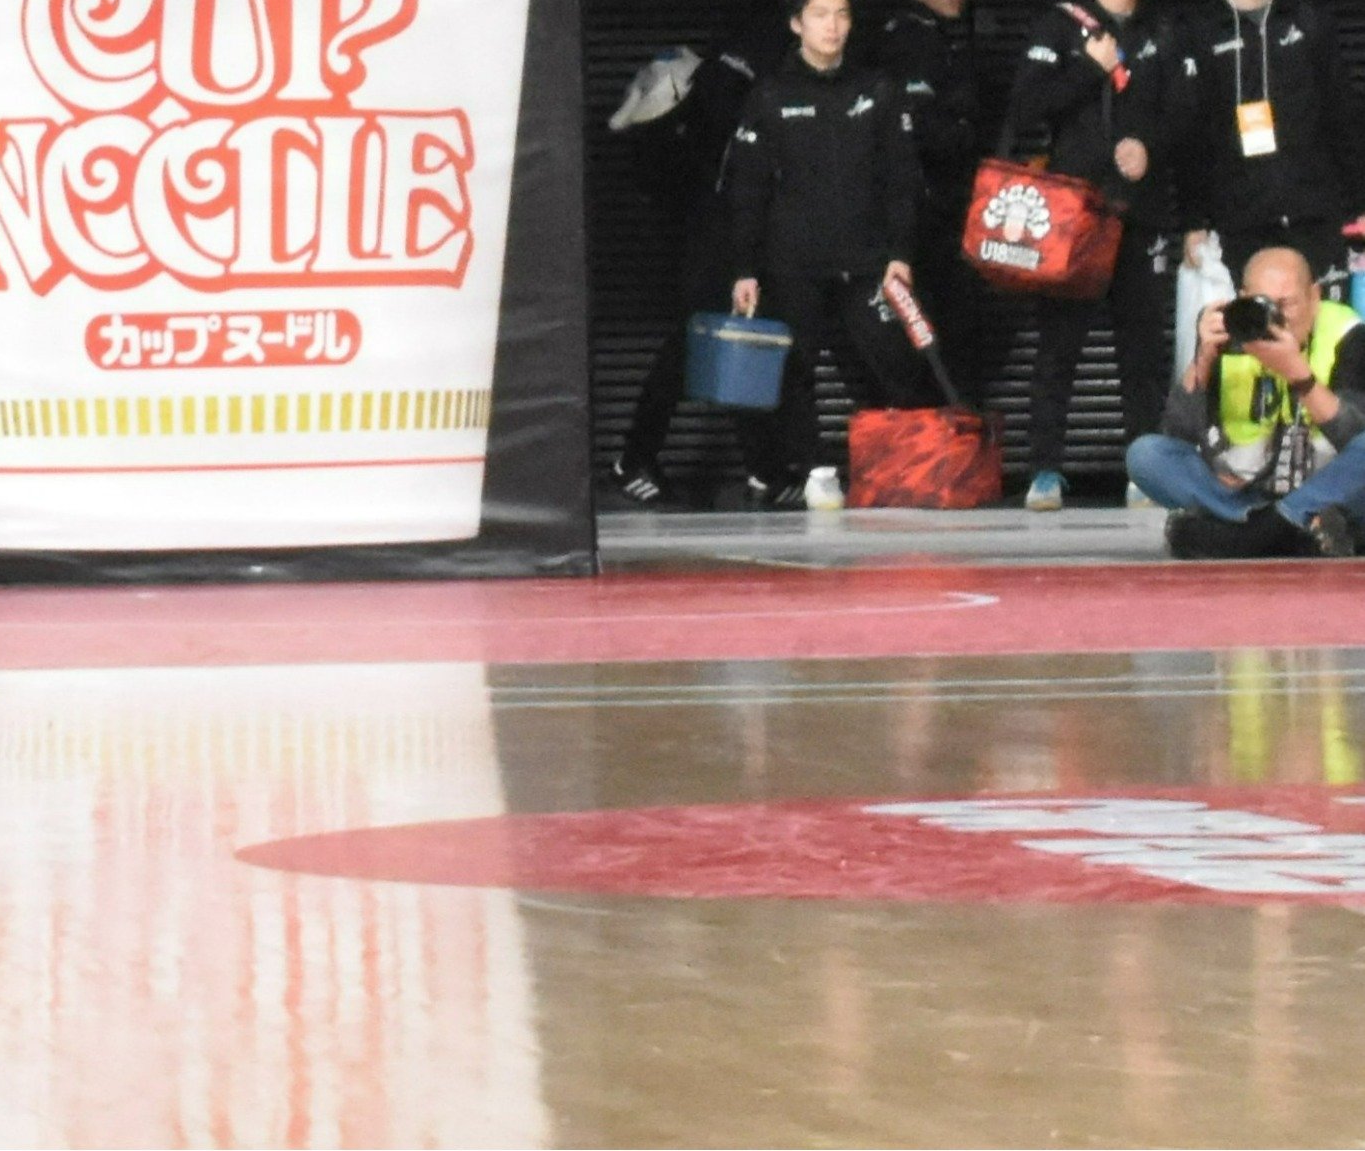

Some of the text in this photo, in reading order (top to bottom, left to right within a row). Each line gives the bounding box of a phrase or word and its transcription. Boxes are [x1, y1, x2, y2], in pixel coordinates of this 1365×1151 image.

[99, 313, 352, 366] カップヌードル
